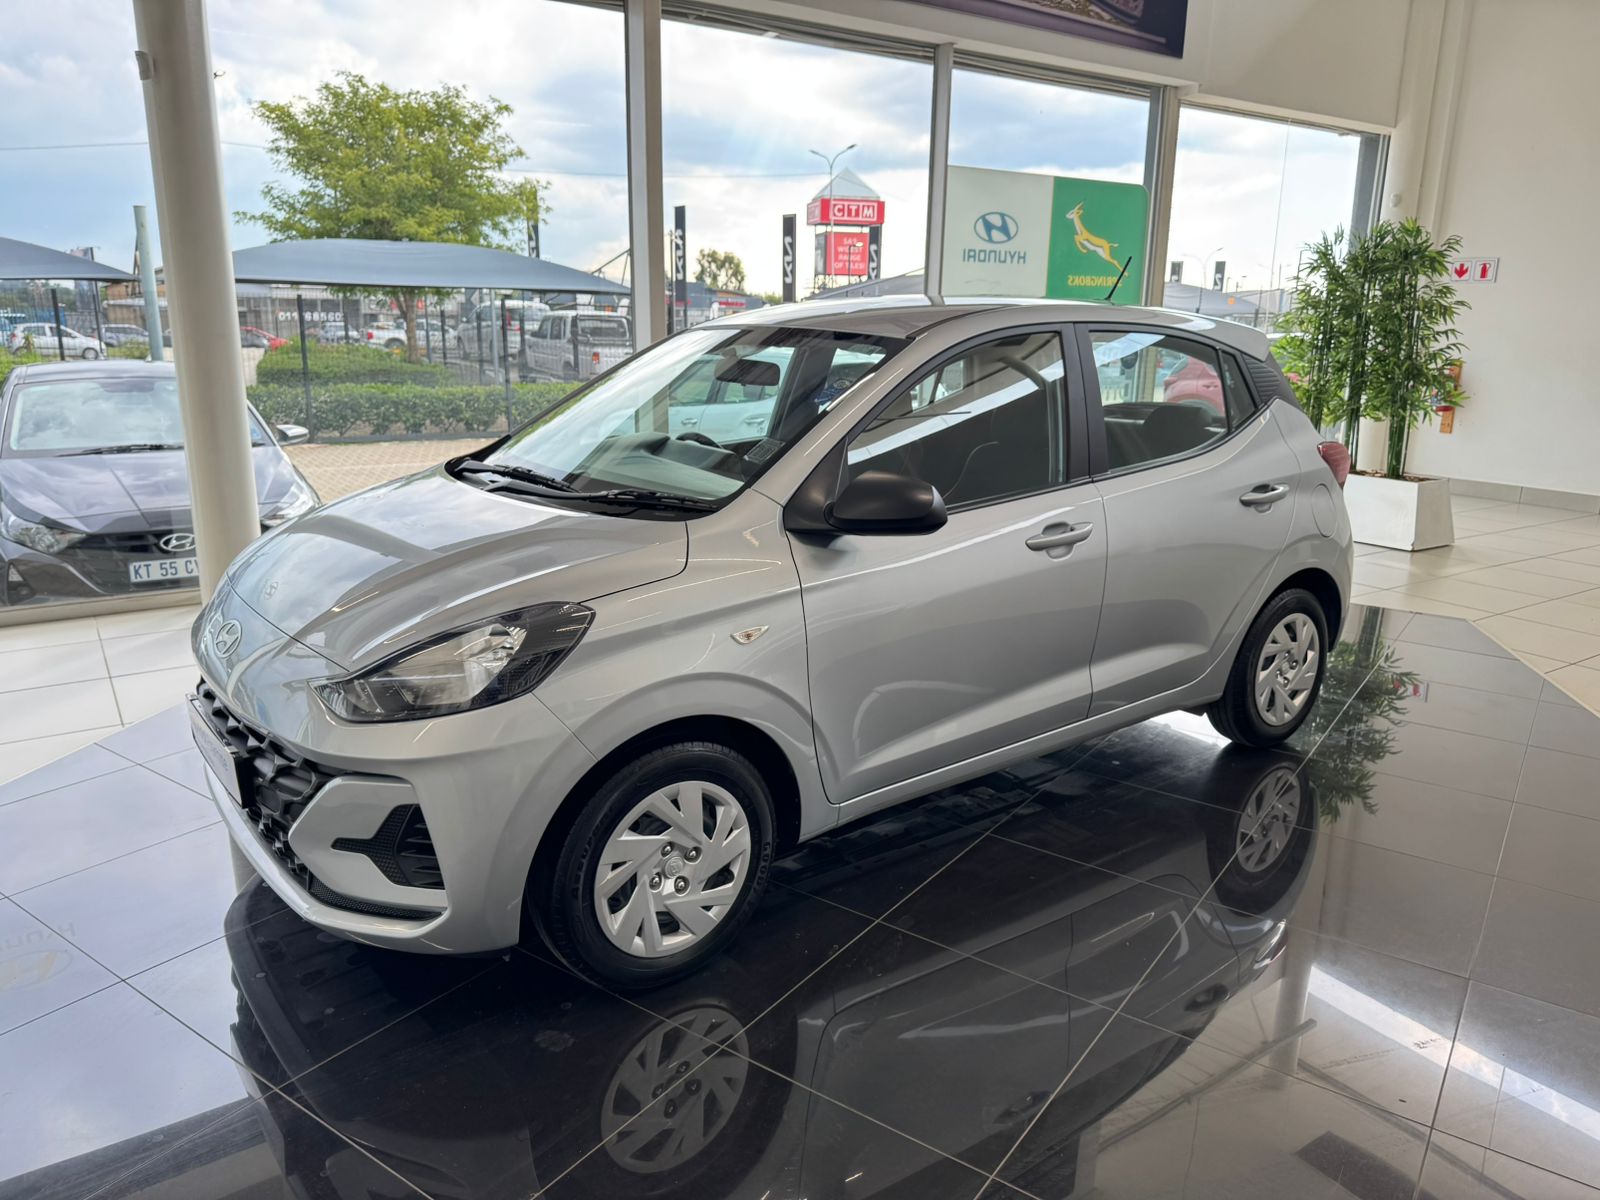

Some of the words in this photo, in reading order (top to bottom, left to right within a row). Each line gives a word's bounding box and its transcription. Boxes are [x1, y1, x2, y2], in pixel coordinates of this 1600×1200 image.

[833, 204, 874, 219] CTM
[133, 563, 152, 580] KT
[160, 561, 178, 577] 55
